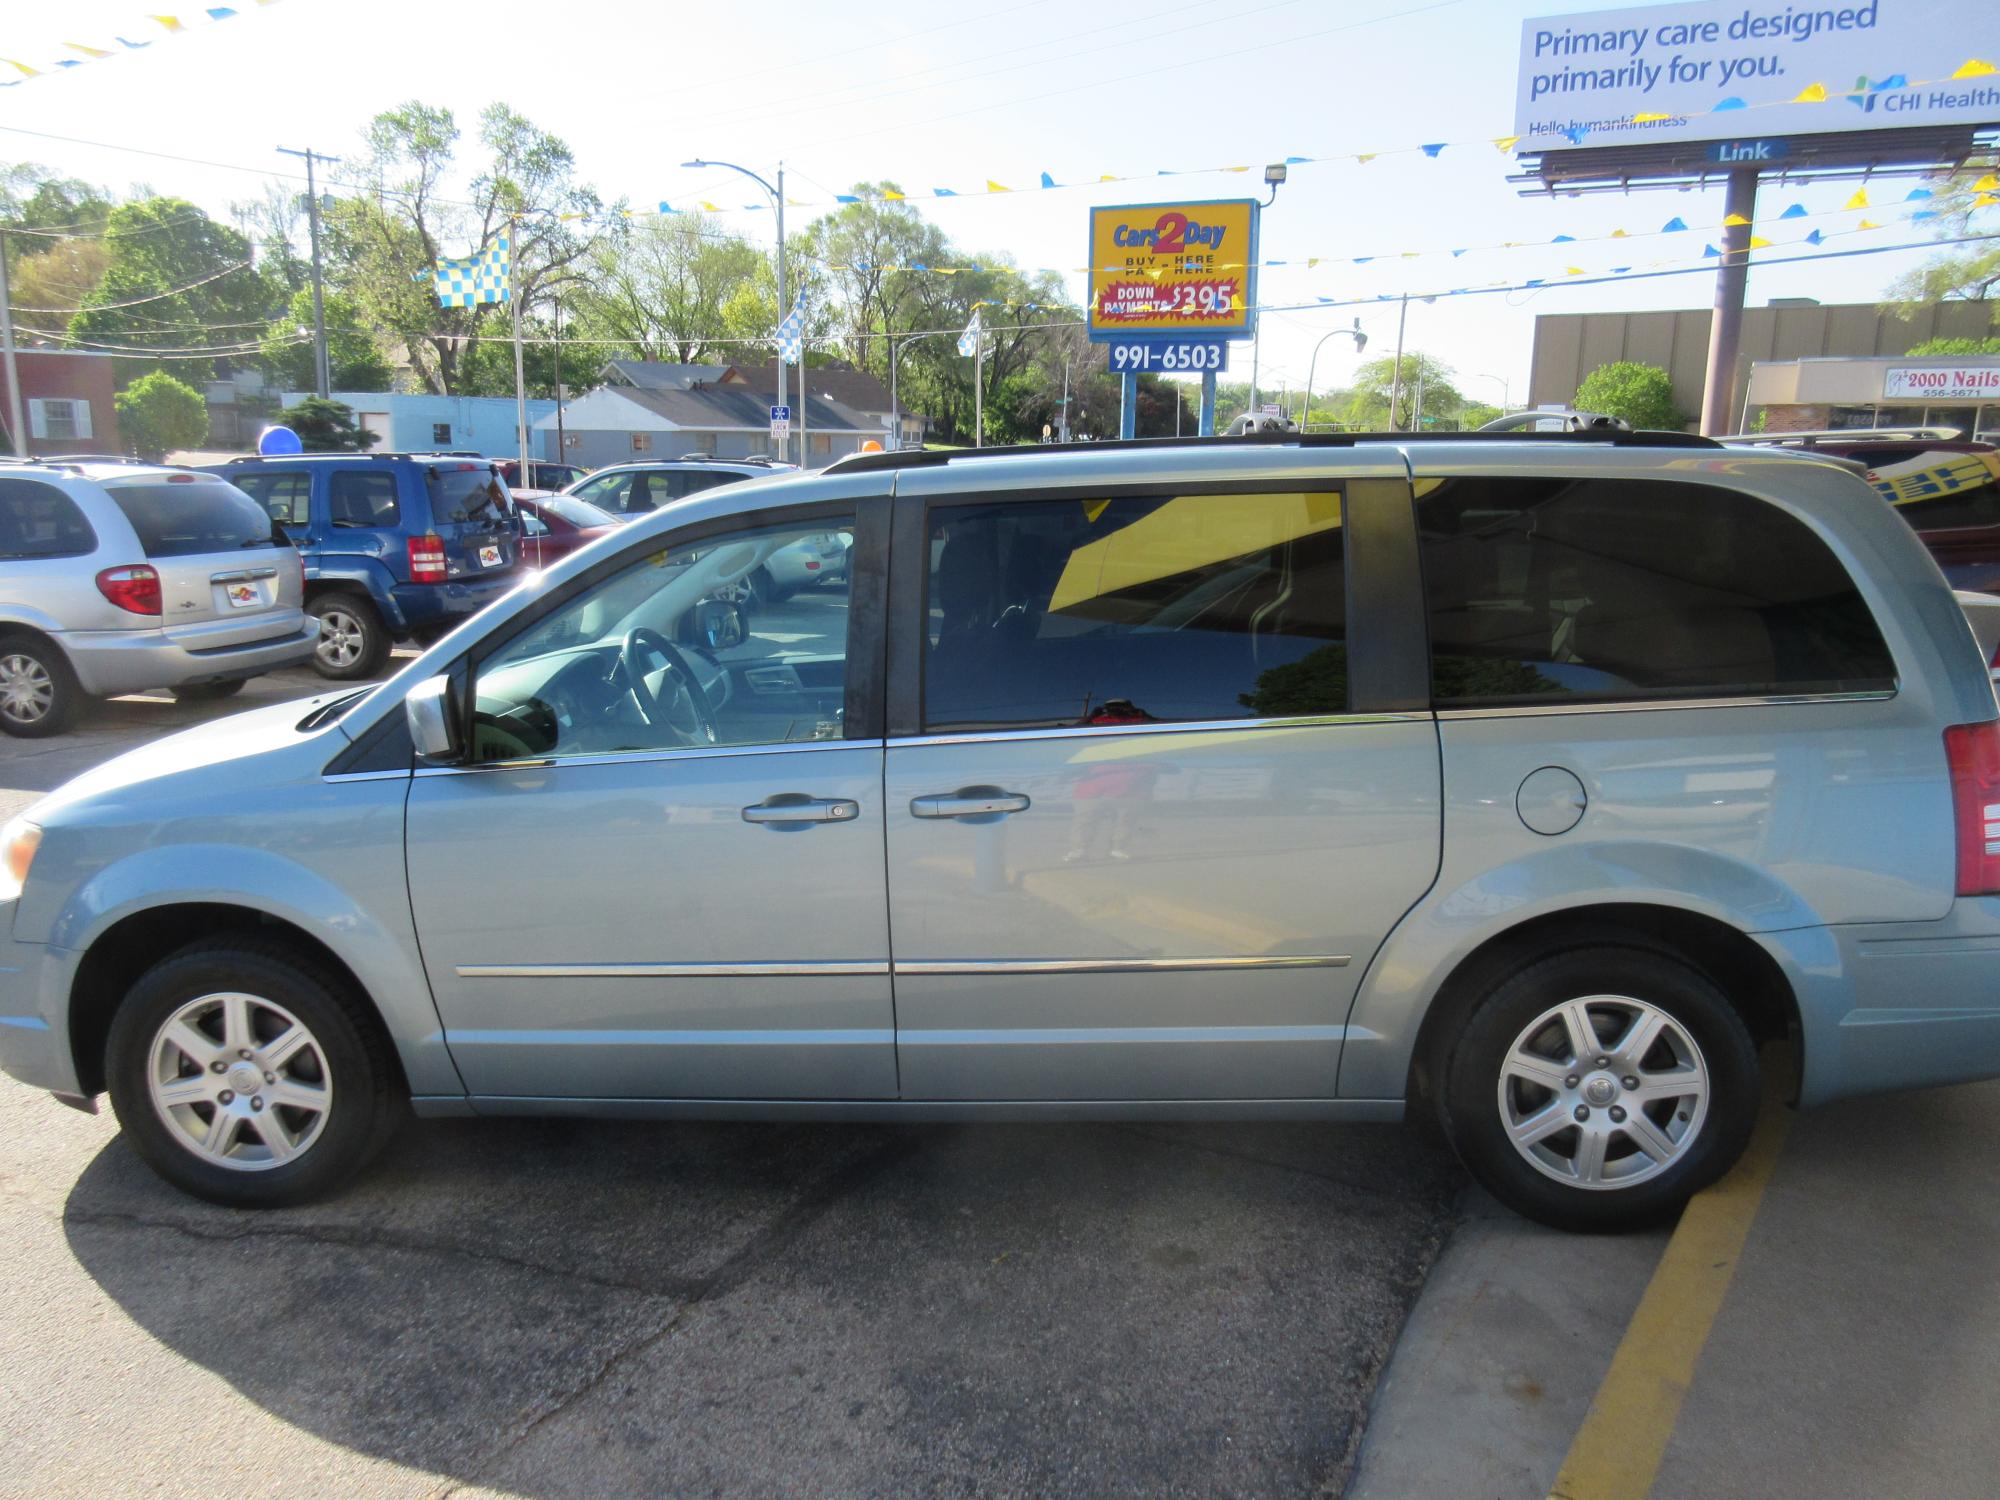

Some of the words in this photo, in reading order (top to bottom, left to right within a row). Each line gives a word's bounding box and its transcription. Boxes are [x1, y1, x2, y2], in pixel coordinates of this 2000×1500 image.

[1535, 29, 1648, 57] Primary
[1656, 21, 1719, 46] care
[1729, 0, 1878, 42] designed
[1531, 60, 1662, 101] primarily
[1669, 55, 1711, 84] for
[1719, 56, 1784, 87] you.
[1885, 95, 1919, 112] CHI
[1929, 88, 2000, 109] Health
[1529, 121, 1565, 136] Hello
[1719, 142, 1770, 162] Link
[1185, 223, 1226, 249] Day
[1126, 257, 1155, 266] BUY
[1174, 255, 1214, 264] HERE
[1126, 267, 1155, 276] PA
[1118, 287, 1154, 299] DOWN
[1174, 285, 1231, 315] $395
[1115, 345, 1220, 369] 991-6503
[1908, 373, 1947, 387] 2000
[1953, 371, 1999, 387] Nails
[1923, 389, 1980, 397] 556-5671
